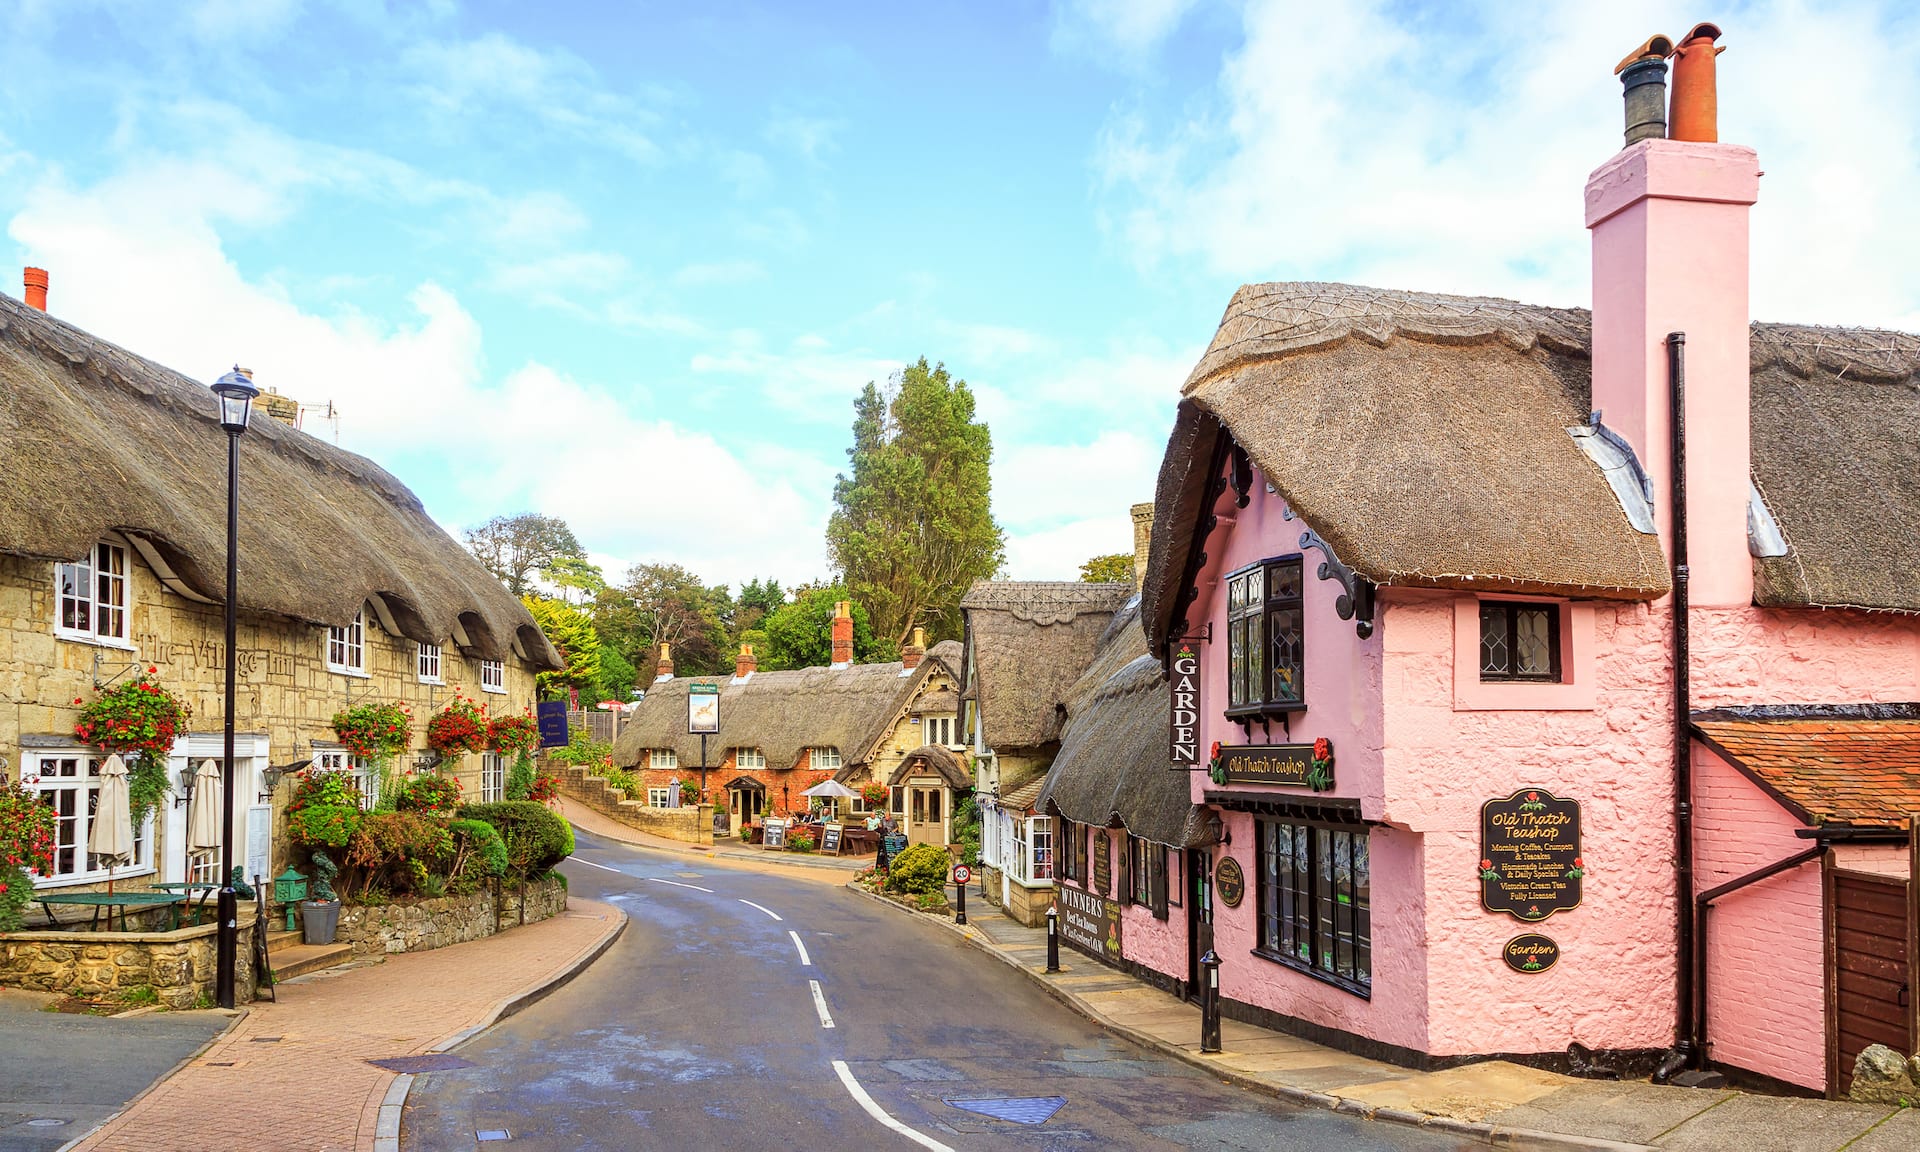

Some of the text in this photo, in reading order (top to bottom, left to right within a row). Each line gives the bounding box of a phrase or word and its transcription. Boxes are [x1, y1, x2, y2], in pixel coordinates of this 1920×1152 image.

[137, 633, 295, 677] The Villge Inn
[1172, 658, 1198, 761] GARDEN
[1229, 756, 1306, 780] Old Thatch Teashop
[1492, 812, 1571, 826] Old Thatch
[1505, 826, 1560, 841] Teashop
[1491, 844, 1519, 852] Morning
[1520, 843, 1543, 851] Coffee,
[957, 870, 967, 878] 20
[1515, 871, 1533, 880] Daily
[1533, 871, 1559, 879] Specials
[1500, 882, 1529, 890] Victorian
[1552, 881, 1567, 889] Teas
[1061, 887, 1102, 918] WINNERS
[1510, 892, 1557, 901] Fully Licensed
[1066, 909, 1076, 923] Best
[1509, 943, 1555, 956] Garden
